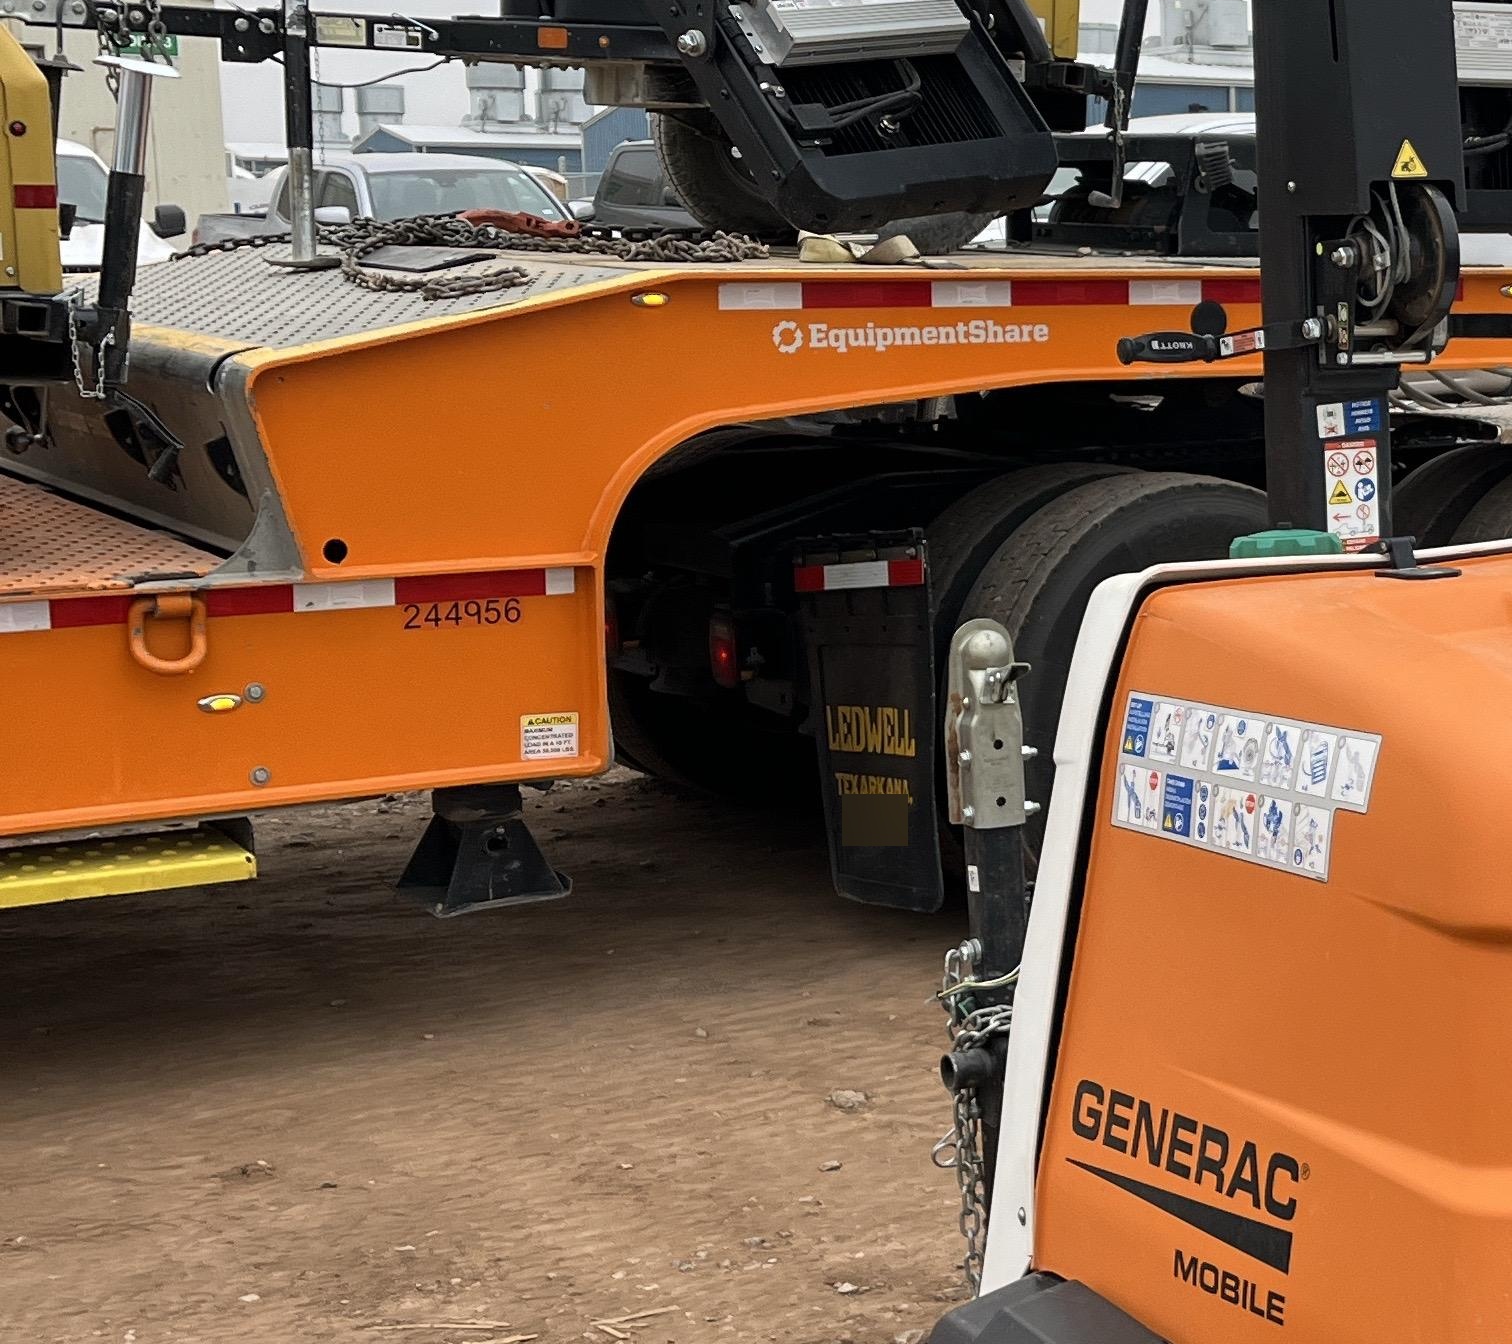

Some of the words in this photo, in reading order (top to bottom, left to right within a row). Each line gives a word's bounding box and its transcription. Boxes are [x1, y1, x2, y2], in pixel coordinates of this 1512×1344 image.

[809, 318, 1049, 353] EquipmentShare
[1160, 342, 1194, 350] KNOTT
[402, 597, 522, 630] 244956
[535, 716, 571, 725] CAUTION
[826, 705, 916, 757] LEDWELL
[1071, 1079, 1300, 1221] GENERAC
[1173, 1249, 1286, 1326] MOBILE
